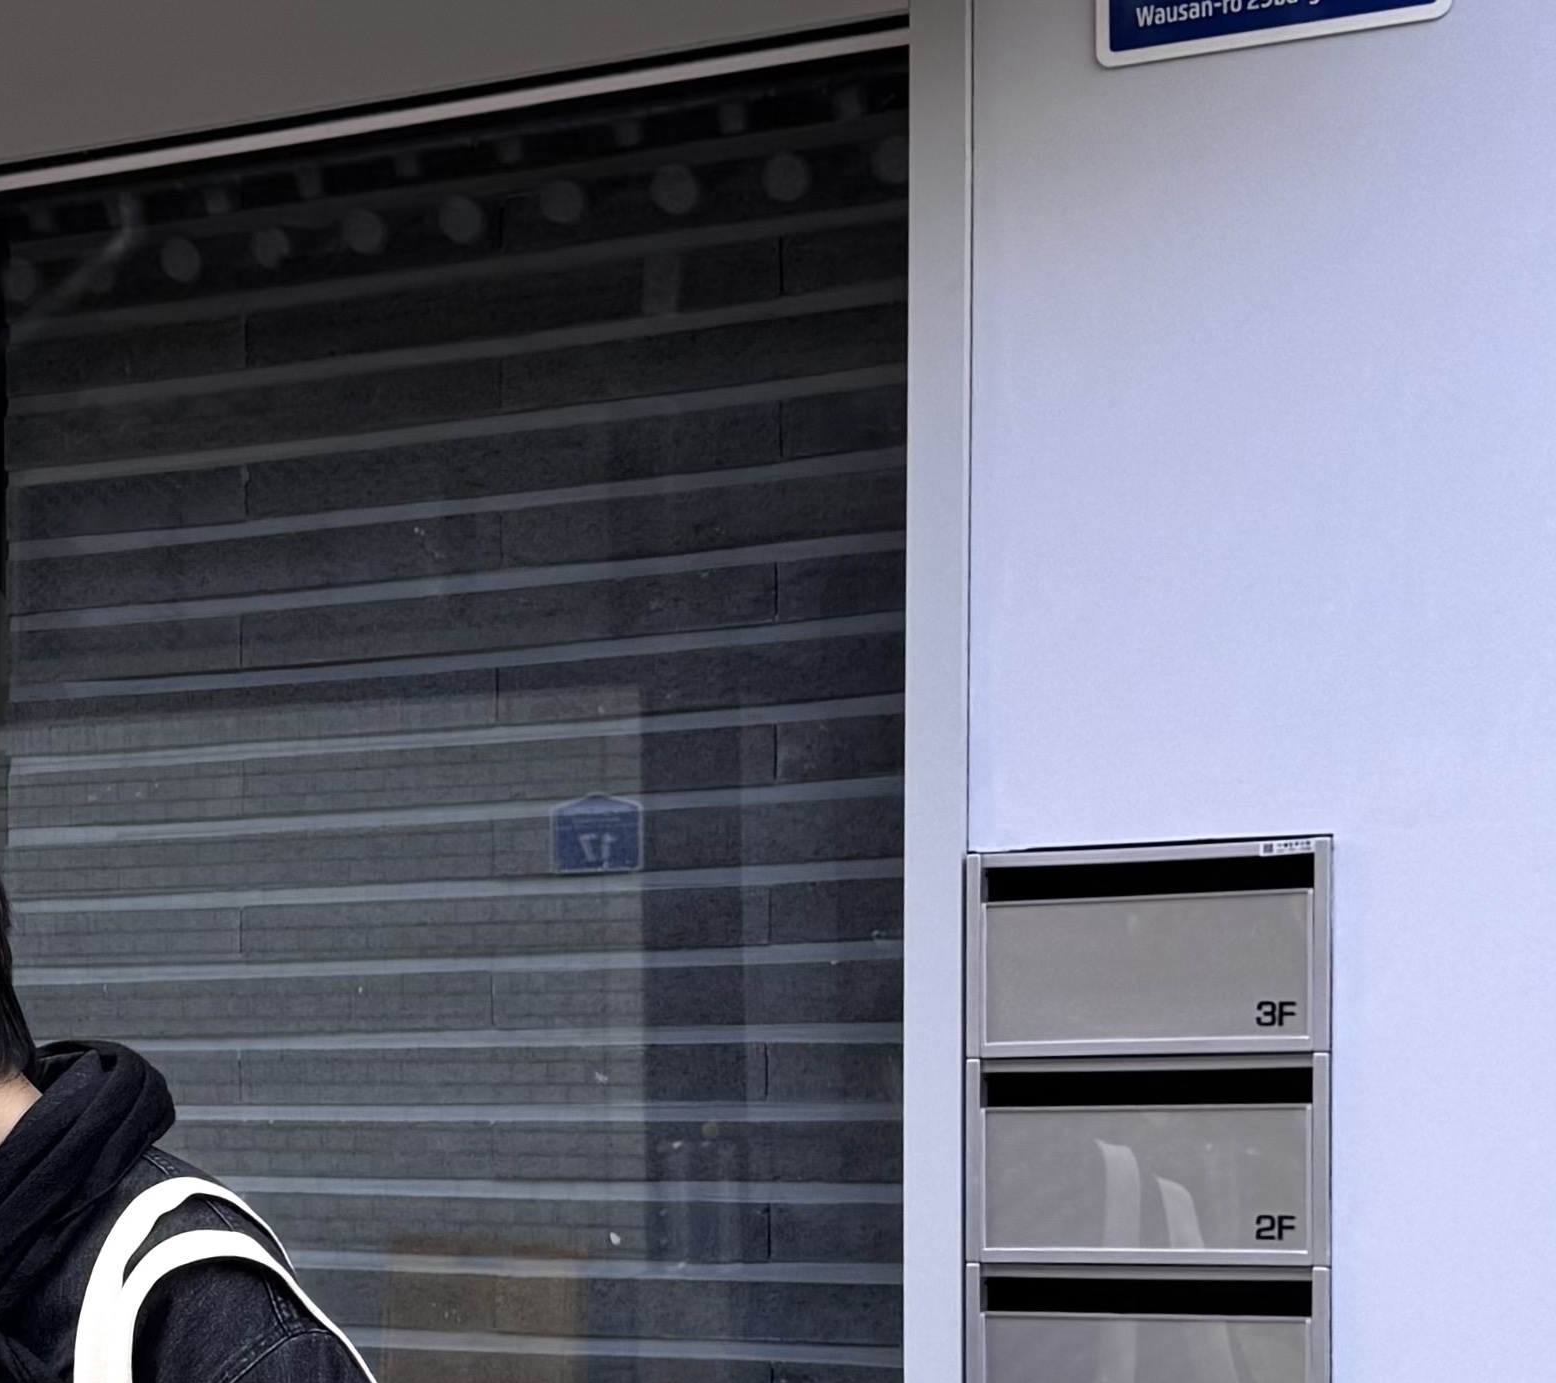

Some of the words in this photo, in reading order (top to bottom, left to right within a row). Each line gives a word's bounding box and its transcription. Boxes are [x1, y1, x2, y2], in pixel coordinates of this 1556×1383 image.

[1136, 0, 1243, 28] Wausan-ro
[1256, 1000, 1297, 1027] 3F
[1255, 1214, 1296, 1241] 2F
